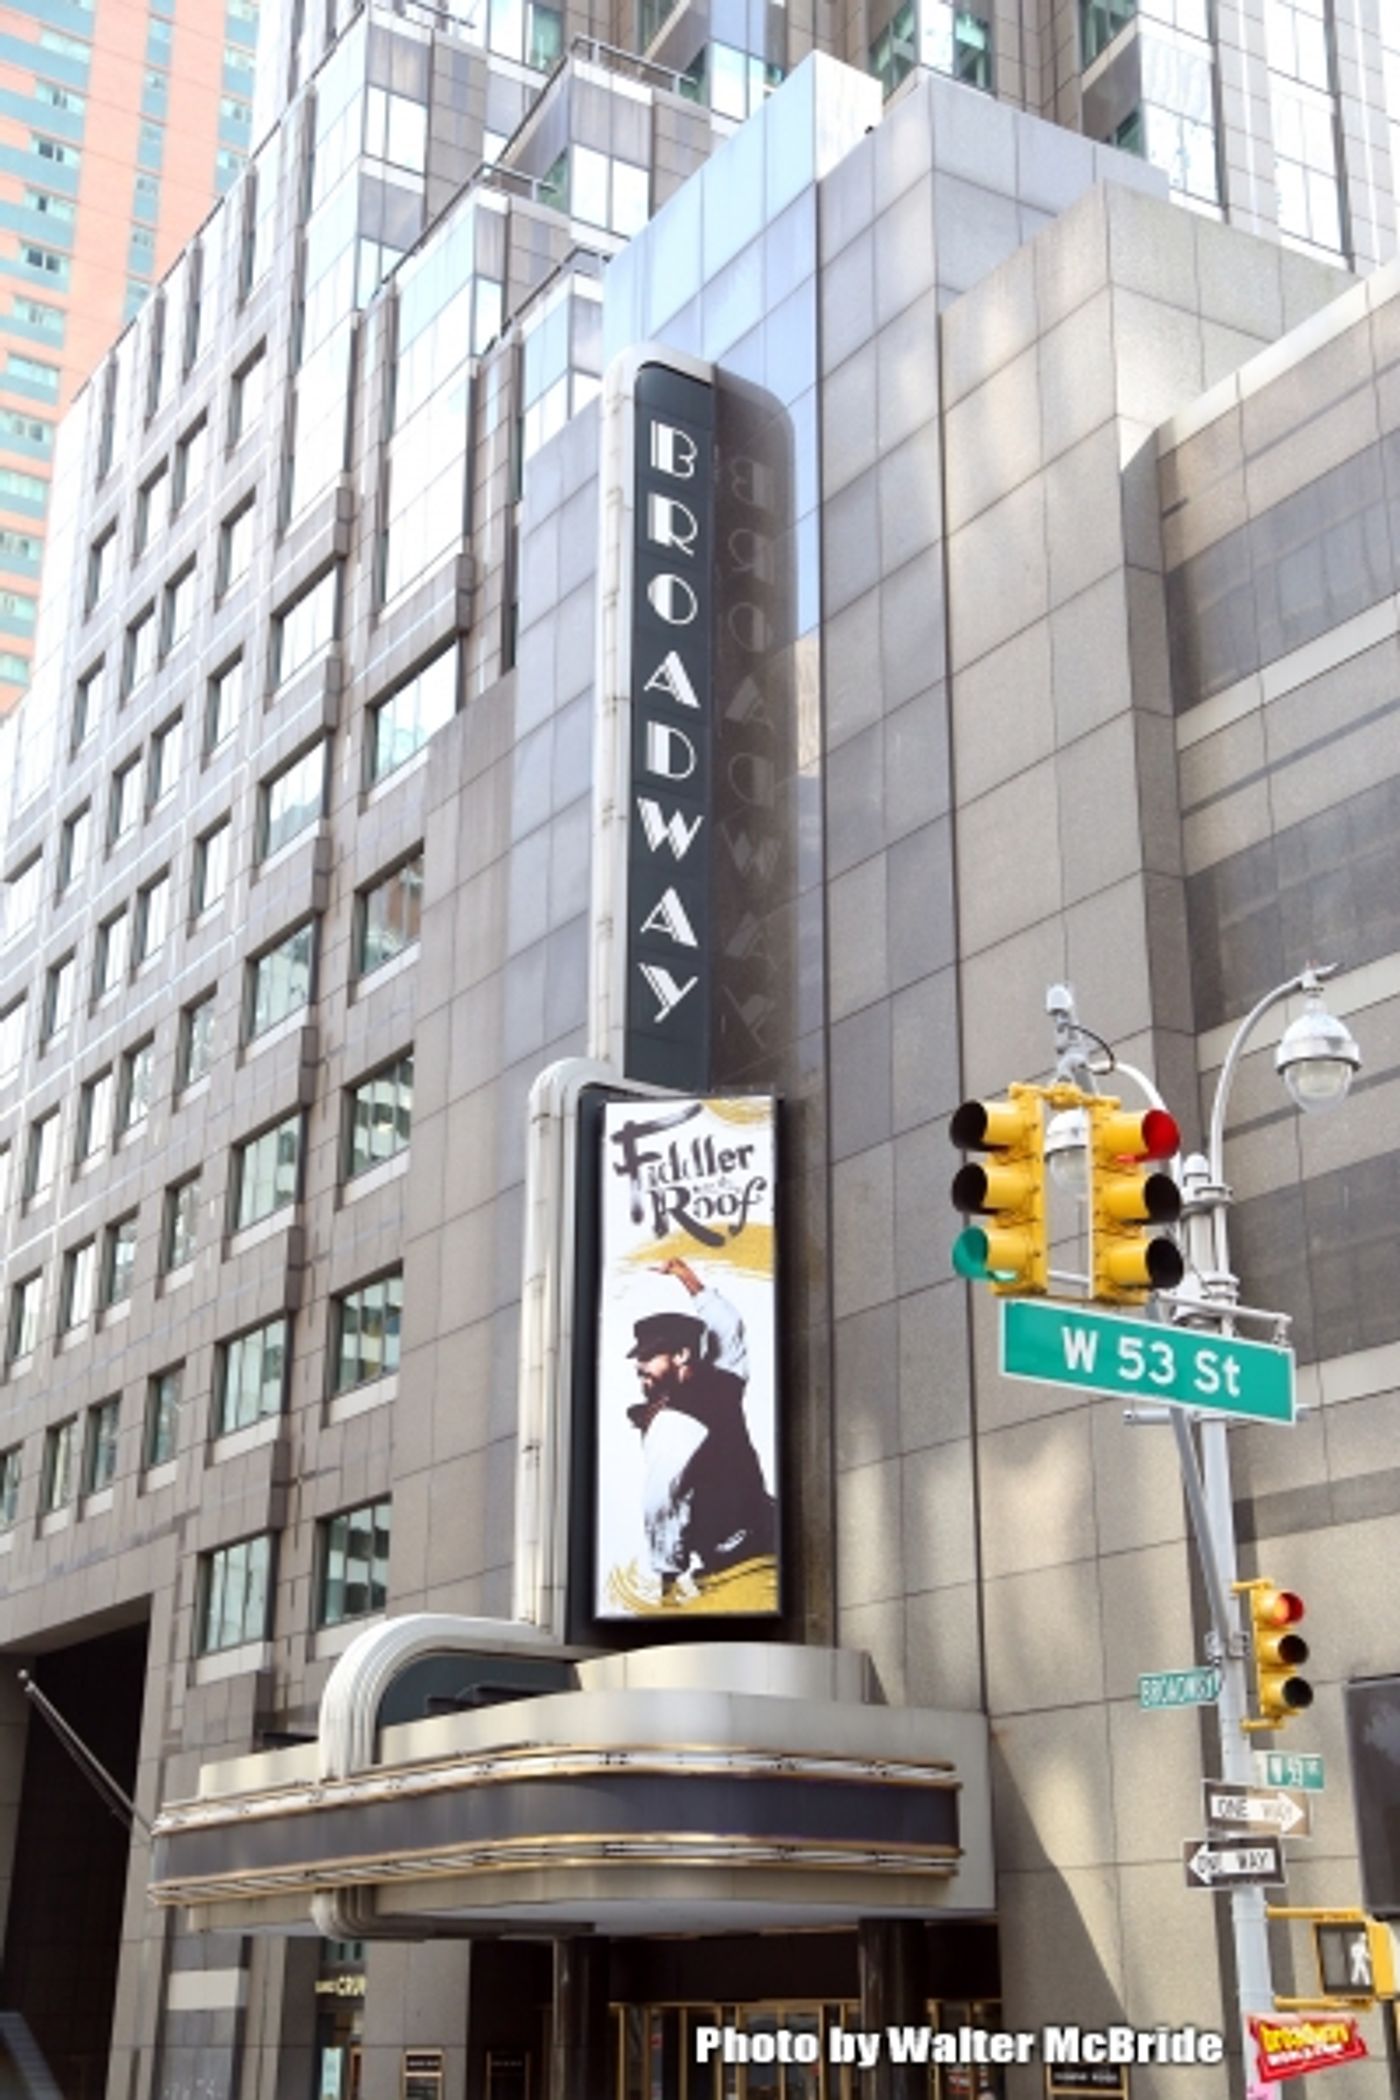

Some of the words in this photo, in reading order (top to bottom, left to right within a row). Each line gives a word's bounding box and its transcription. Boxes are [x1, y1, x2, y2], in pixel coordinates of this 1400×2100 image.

[636, 419, 704, 1023] BROADWAY
[610, 1102, 755, 1224] Fiddler
[646, 1177, 768, 1247] Roof
[1062, 1326, 1098, 1373] W
[1117, 1336, 1176, 1385] 53
[1194, 1350, 1241, 1397] St
[1217, 1798, 1249, 1818] ONE
[1261, 1801, 1296, 1821] WAY
[1236, 1850, 1269, 1870] WAY
